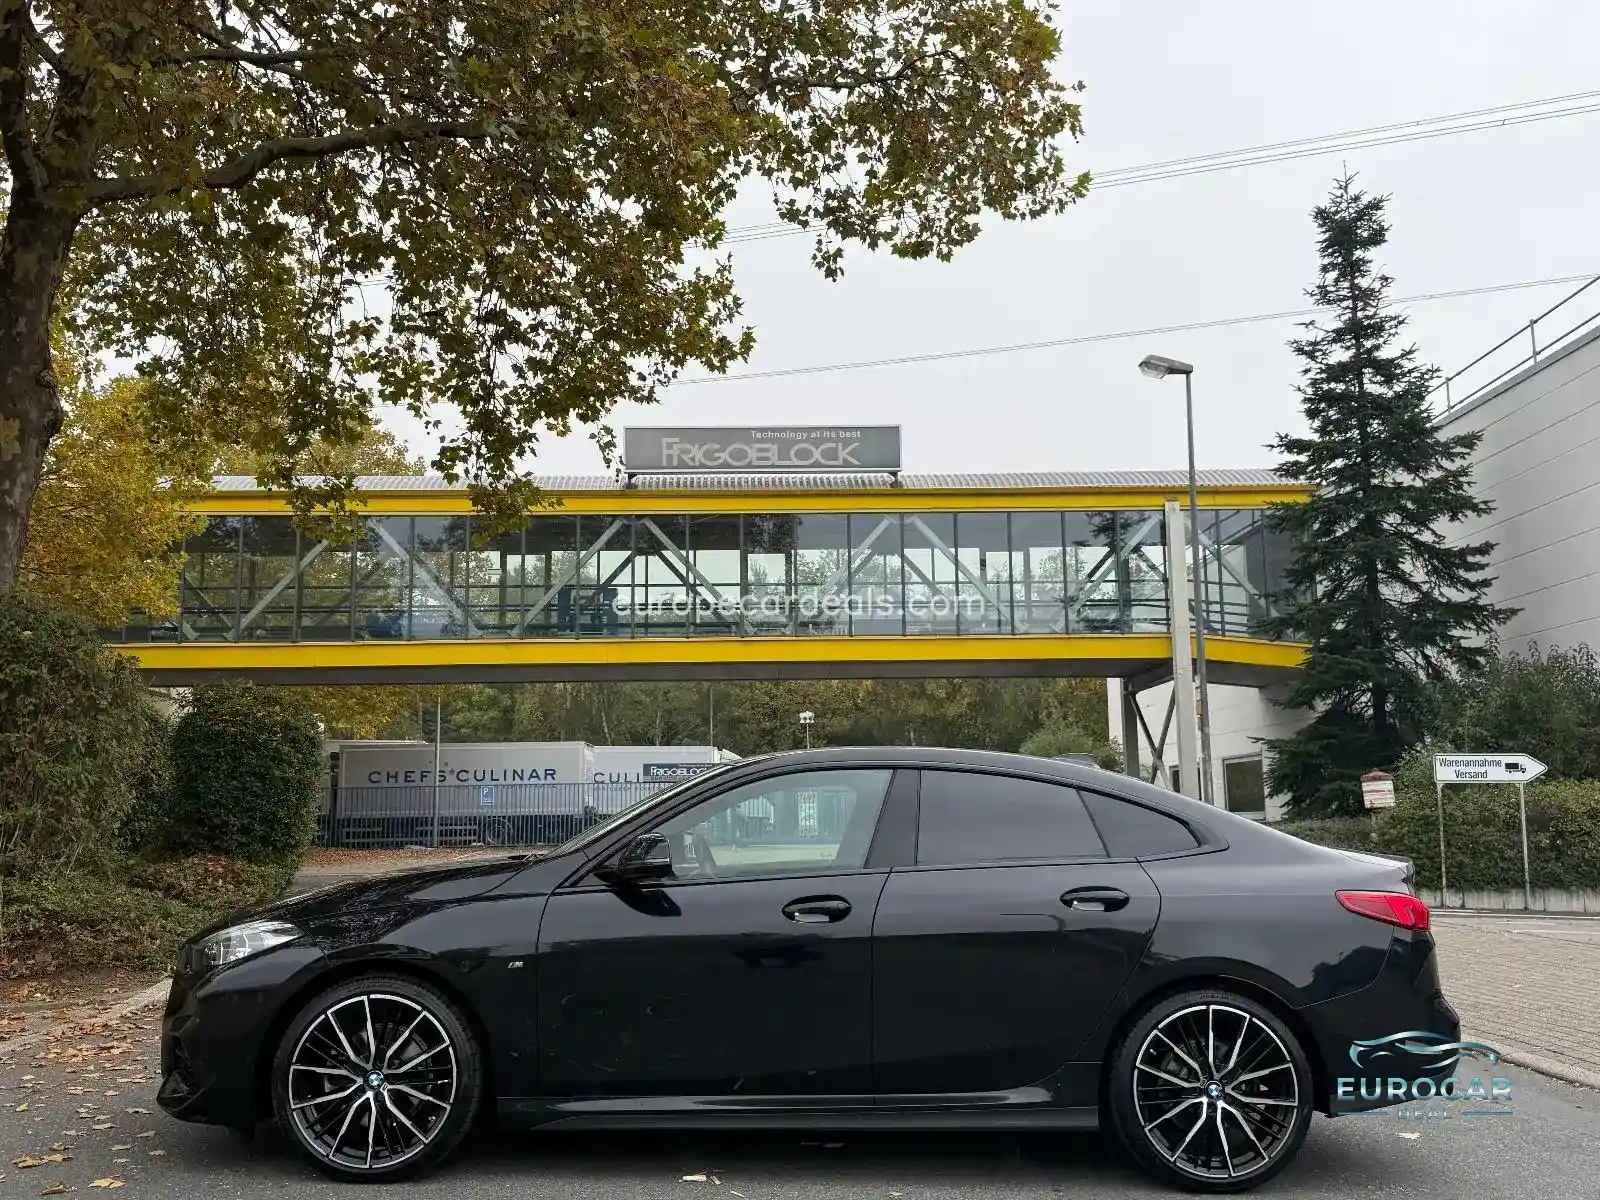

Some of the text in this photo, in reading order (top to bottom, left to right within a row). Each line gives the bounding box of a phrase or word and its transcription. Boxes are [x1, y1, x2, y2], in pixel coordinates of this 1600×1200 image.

[751, 430, 808, 440] Technology
[823, 430, 836, 438] its
[839, 430, 861, 438] best
[660, 437, 862, 467] FRIGOBLOCK
[1438, 757, 1502, 768] Warenannahme
[455, 768, 557, 783] CULINAR
[593, 772, 640, 783] CULI
[1454, 769, 1488, 779] Versand
